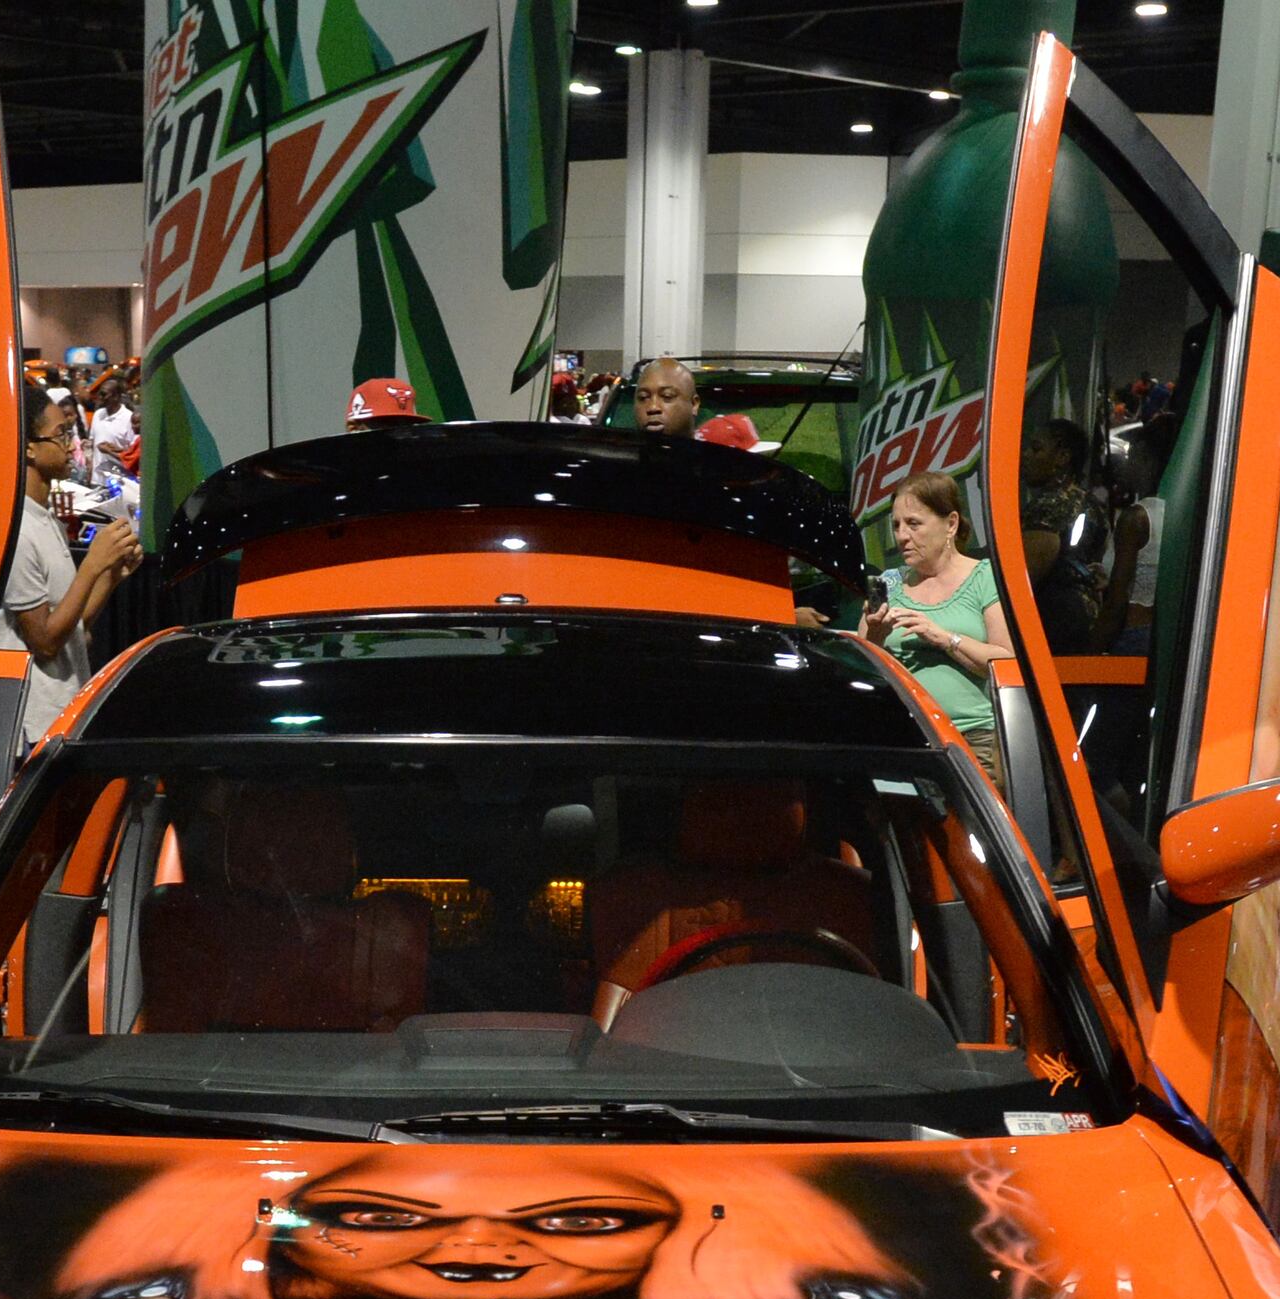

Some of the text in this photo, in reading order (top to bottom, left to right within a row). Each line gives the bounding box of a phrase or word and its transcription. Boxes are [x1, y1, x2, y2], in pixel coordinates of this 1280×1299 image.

[144, 87, 404, 347] ew
[147, 88, 223, 226] tn
[1064, 1112, 1095, 1129] APR
